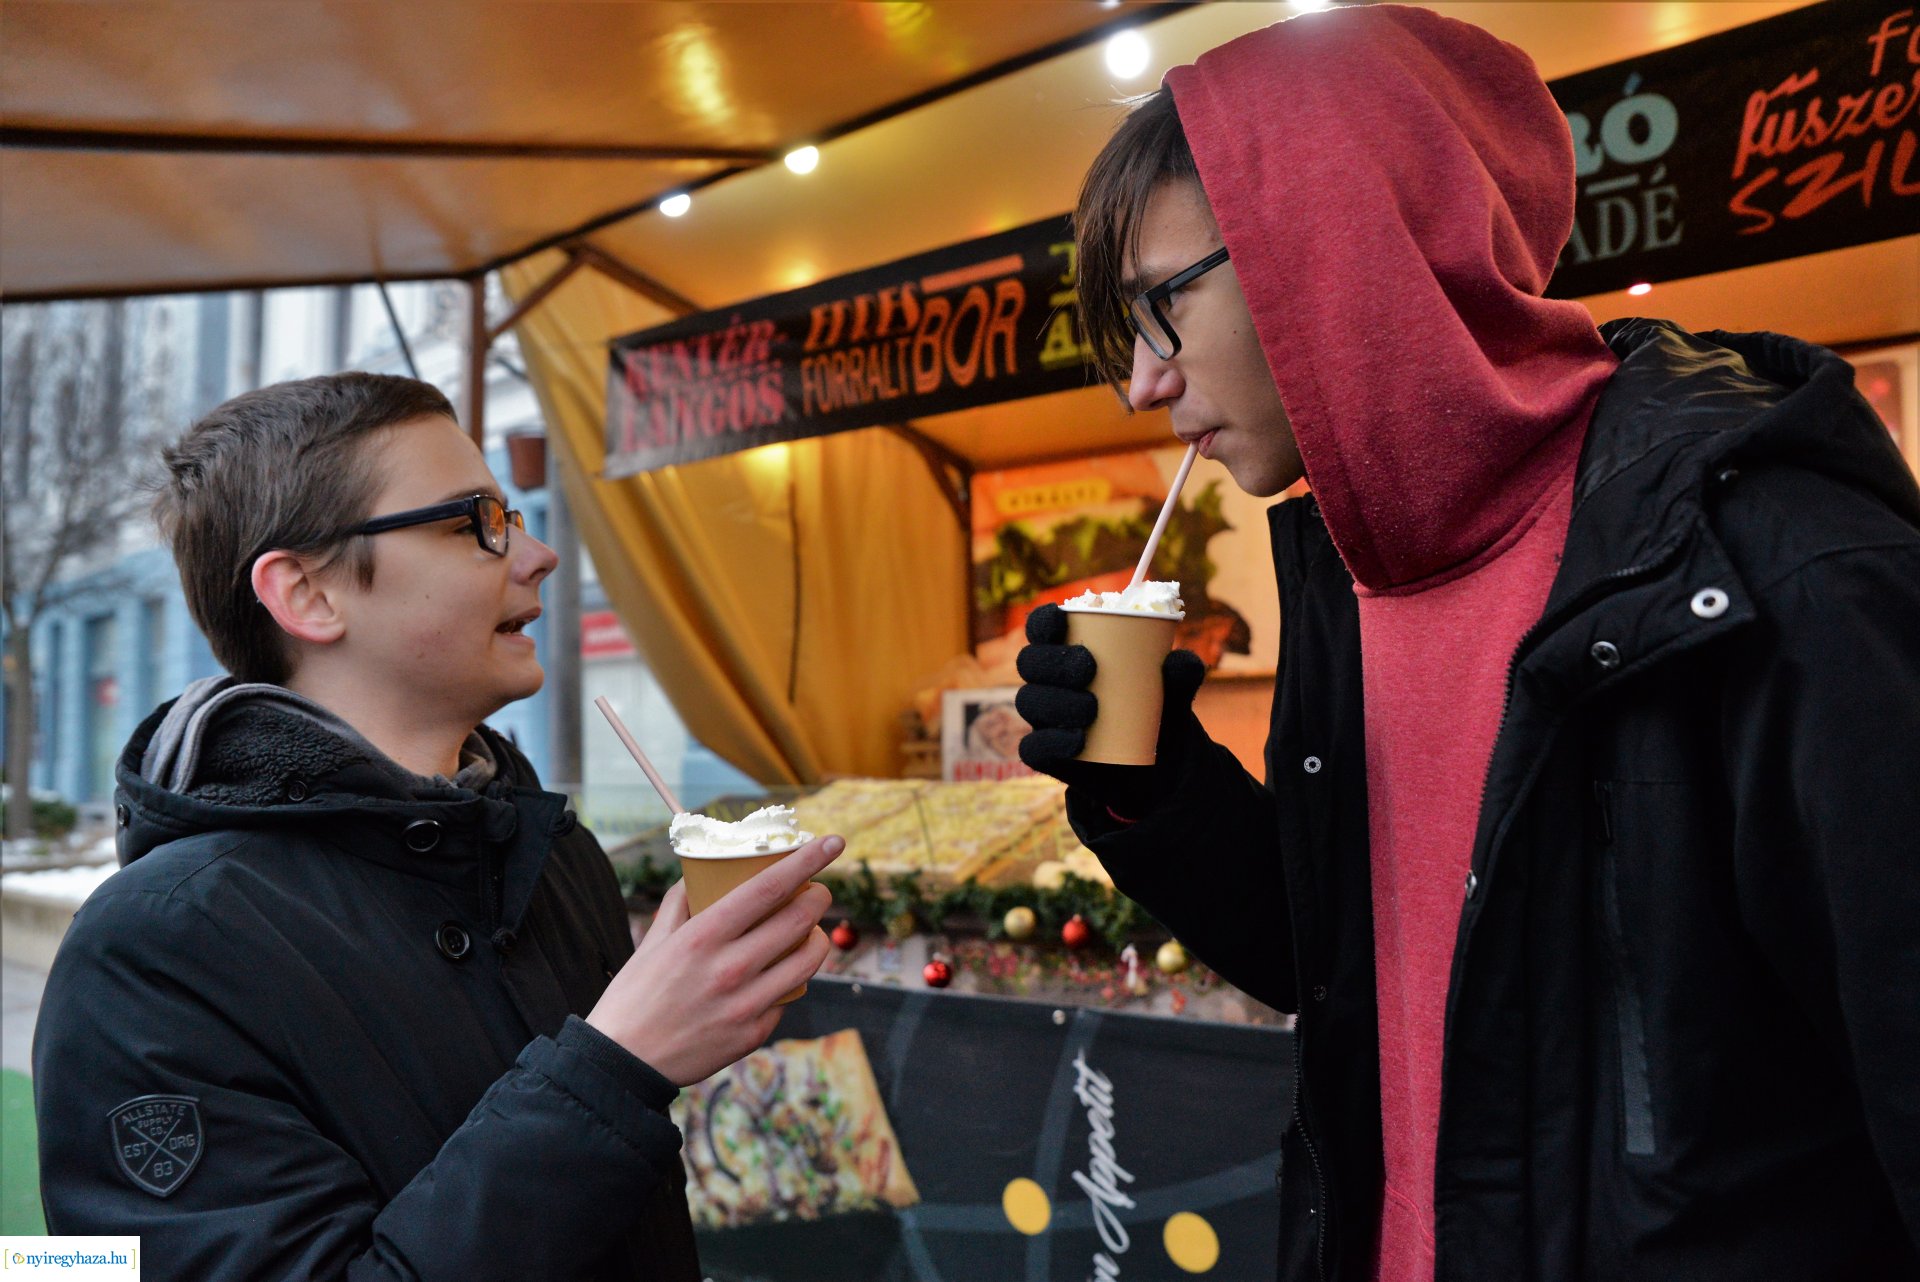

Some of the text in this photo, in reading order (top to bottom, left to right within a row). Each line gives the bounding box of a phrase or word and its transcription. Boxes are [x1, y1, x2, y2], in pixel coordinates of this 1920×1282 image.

[801, 336, 912, 416] FORRALT
[912, 278, 1026, 394] BOR
[121, 1104, 187, 1125] ALLSTATE
[137, 1115, 174, 1129] SUPPLY
[123, 1141, 148, 1158] EST
[169, 1133, 196, 1150] ORG
[153, 1160, 173, 1178] 83
